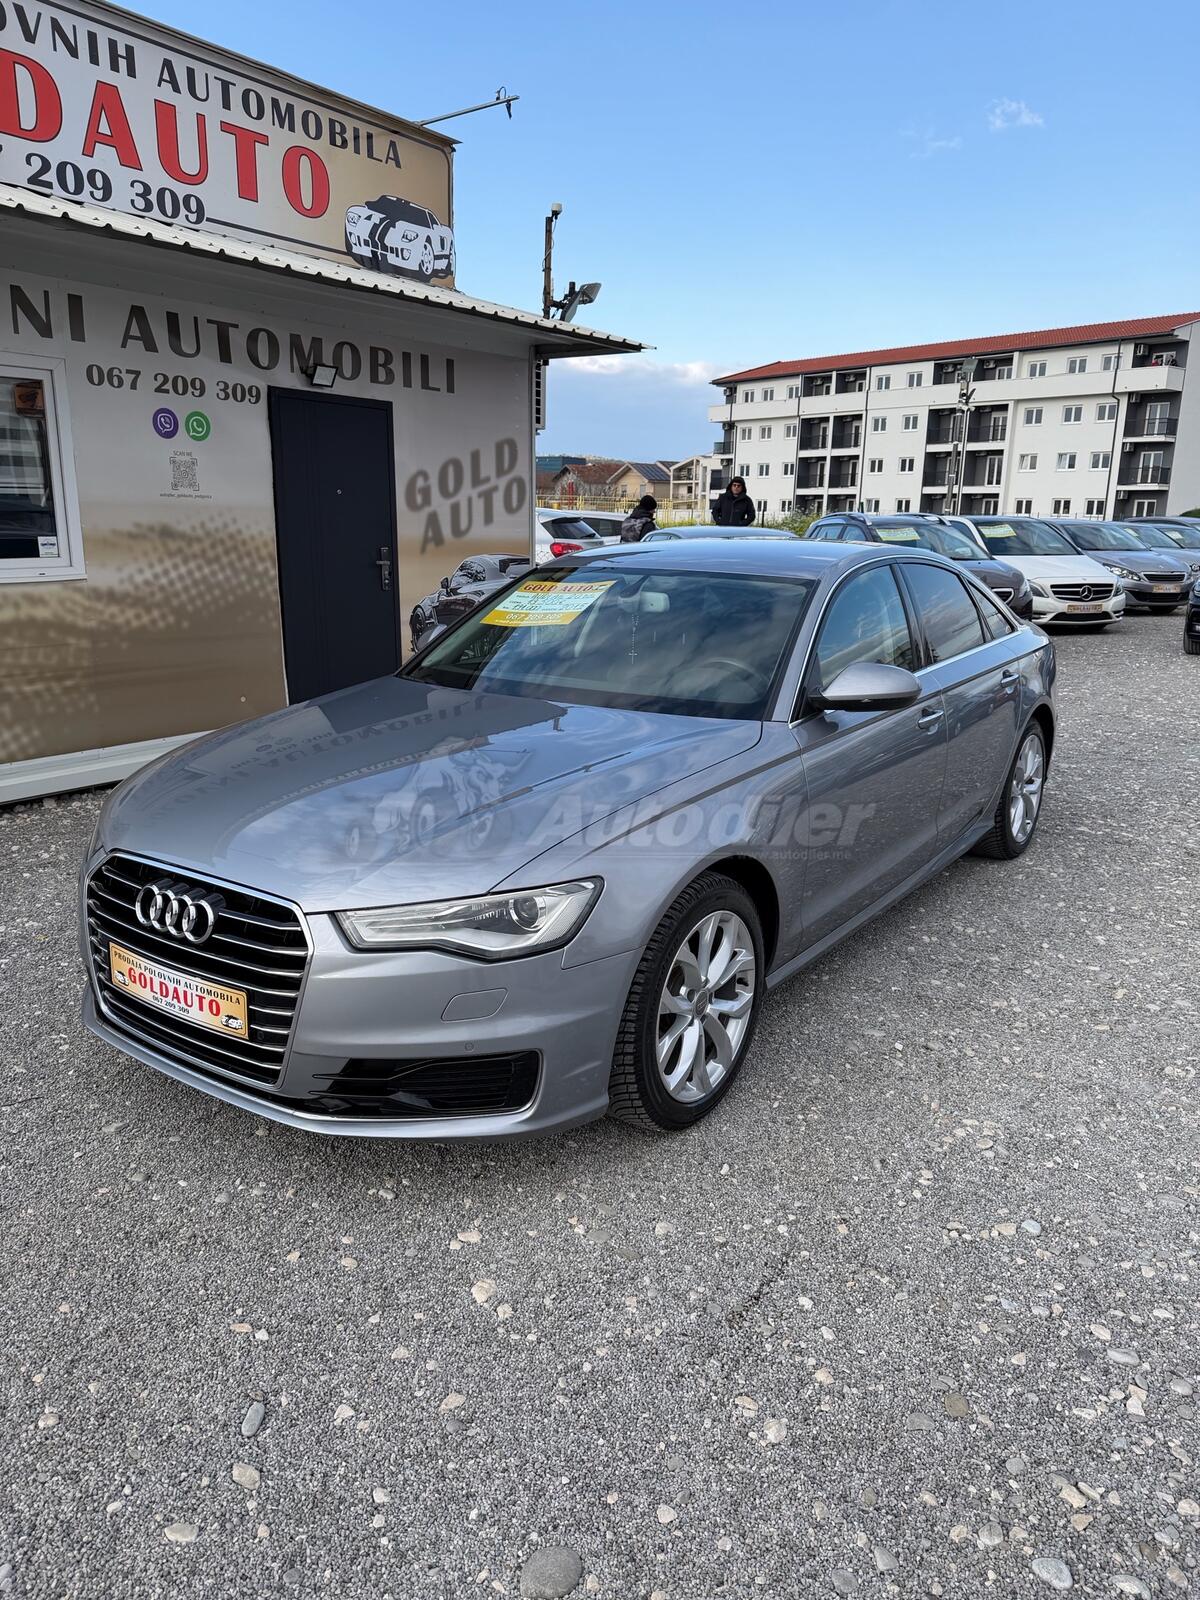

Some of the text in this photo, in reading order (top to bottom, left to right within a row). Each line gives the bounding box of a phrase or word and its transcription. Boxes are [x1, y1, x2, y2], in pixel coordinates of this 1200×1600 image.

[0, 0, 402, 169] VNIH AUTOMOBILA
[0, 48, 331, 219] DAUTO
[25, 152, 206, 225] 209 309
[9, 284, 456, 394] NI AUTOMOBILI
[86, 364, 262, 404] 067 209 309
[404, 437, 519, 513] GOLD
[420, 474, 527, 555] AUTO
[523, 584, 558, 592] GOLD
[113, 950, 241, 1005] PRODAJA POLOVNIH AUTOMOBILA
[127, 966, 221, 1017] GOLDAUTO
[152, 994, 190, 1015] 067 209 309
